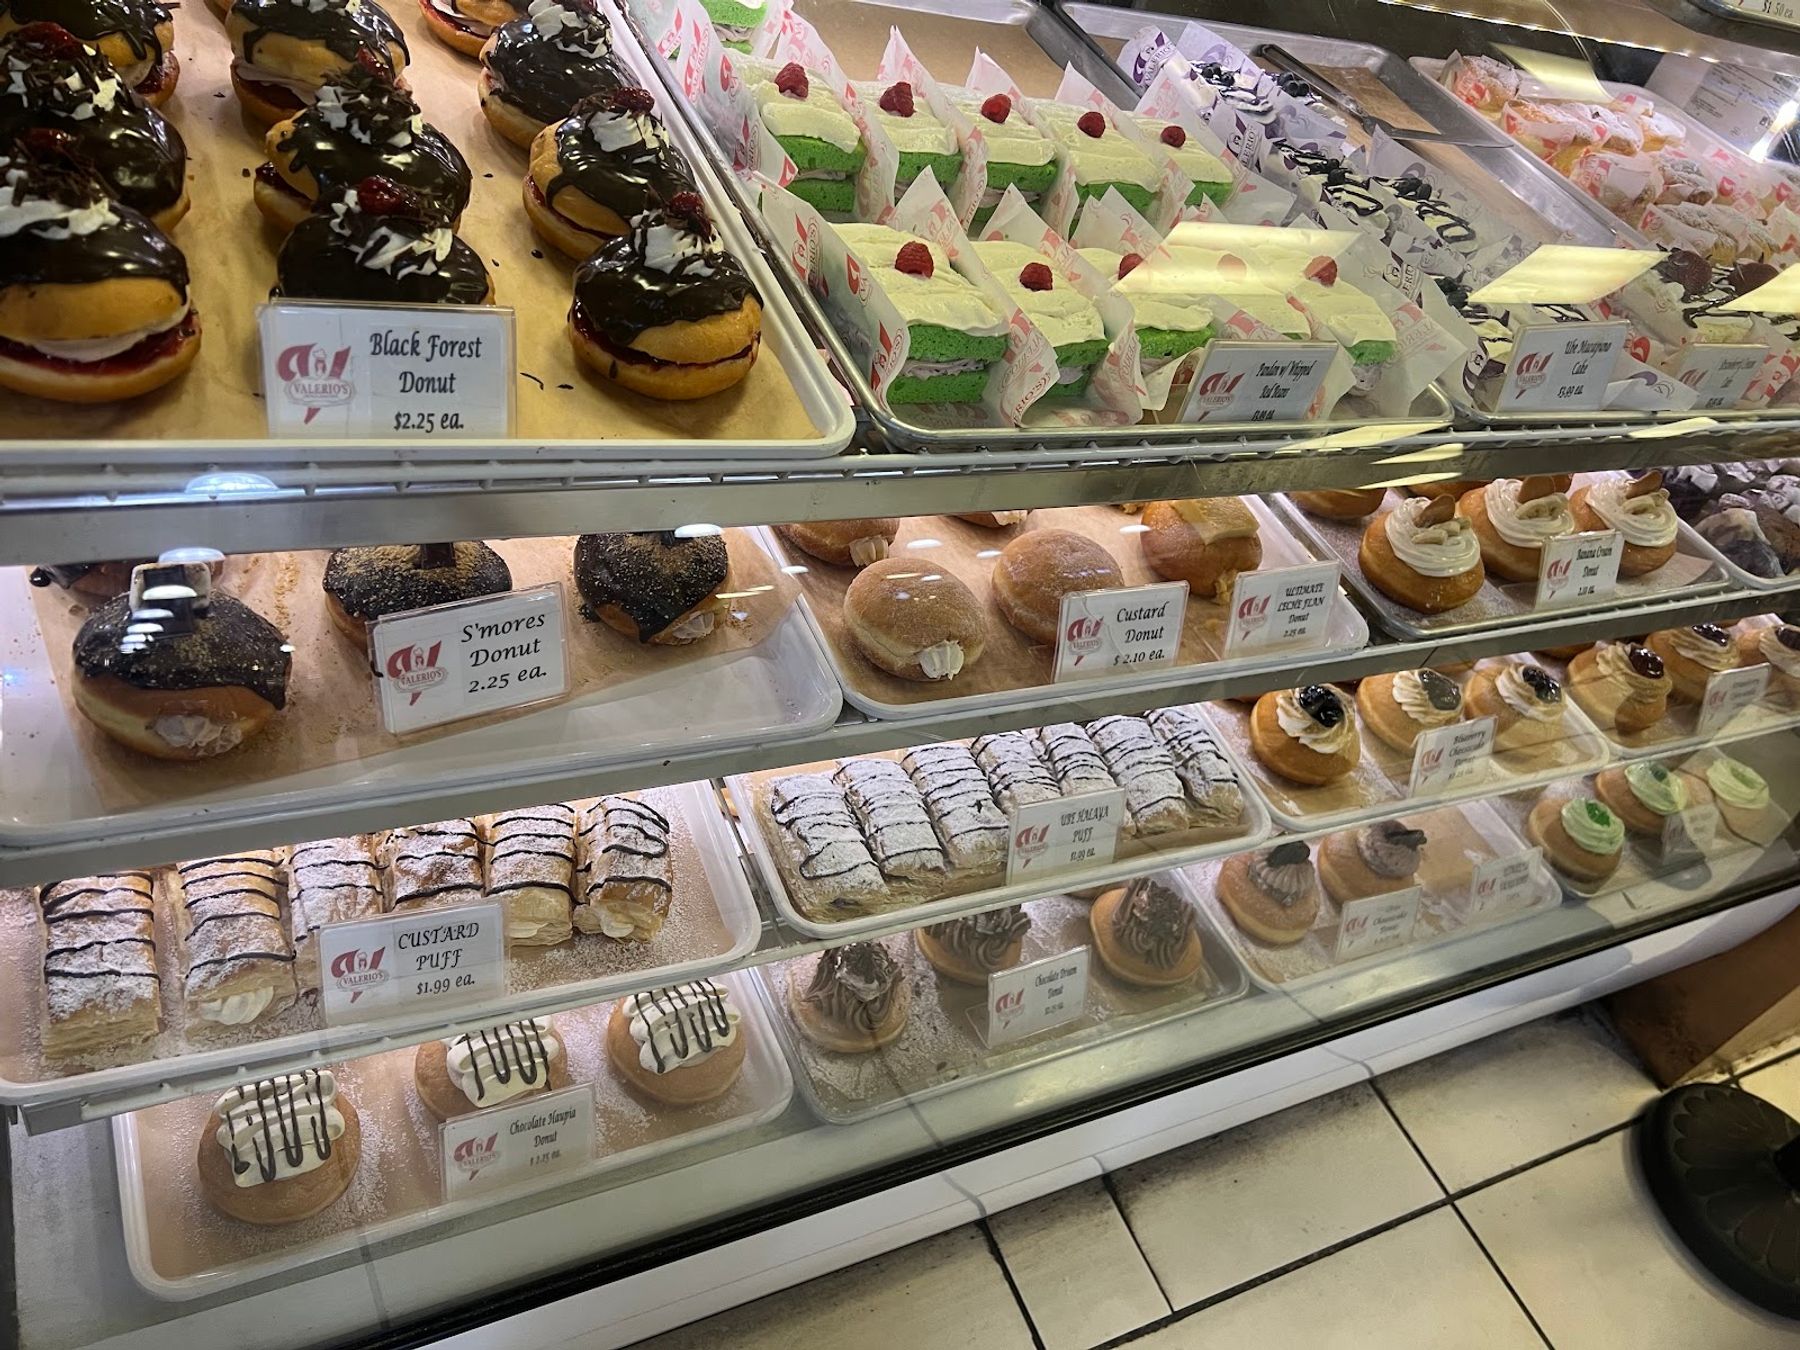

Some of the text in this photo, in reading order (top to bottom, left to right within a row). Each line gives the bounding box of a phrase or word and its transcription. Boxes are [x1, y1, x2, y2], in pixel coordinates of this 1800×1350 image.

[369, 329, 483, 362] Black Forest
[292, 383, 350, 395] VALERIO'S
[398, 371, 457, 393] Donut
[393, 412, 465, 433] $2.25 ea.
[1285, 582, 1325, 597] ULTIMATE
[1116, 601, 1170, 623] Custard
[1277, 596, 1326, 612] LECHE FLAN
[460, 613, 546, 643] S'mores
[1288, 612, 1310, 624] Donut
[1124, 626, 1164, 643] Donut
[469, 638, 542, 667] Donut
[468, 665, 548, 693] 2.25 ea.
[1060, 811, 1077, 826] UBE
[1072, 827, 1094, 843] PUFF
[397, 922, 480, 950] CUSTARD
[416, 948, 463, 971] PUFF
[343, 971, 384, 986] VALERIO'S
[416, 973, 475, 995] $1.99 ea.
[509, 1107, 576, 1136] Chocolate Haupia
[534, 1130, 557, 1148] Donut
